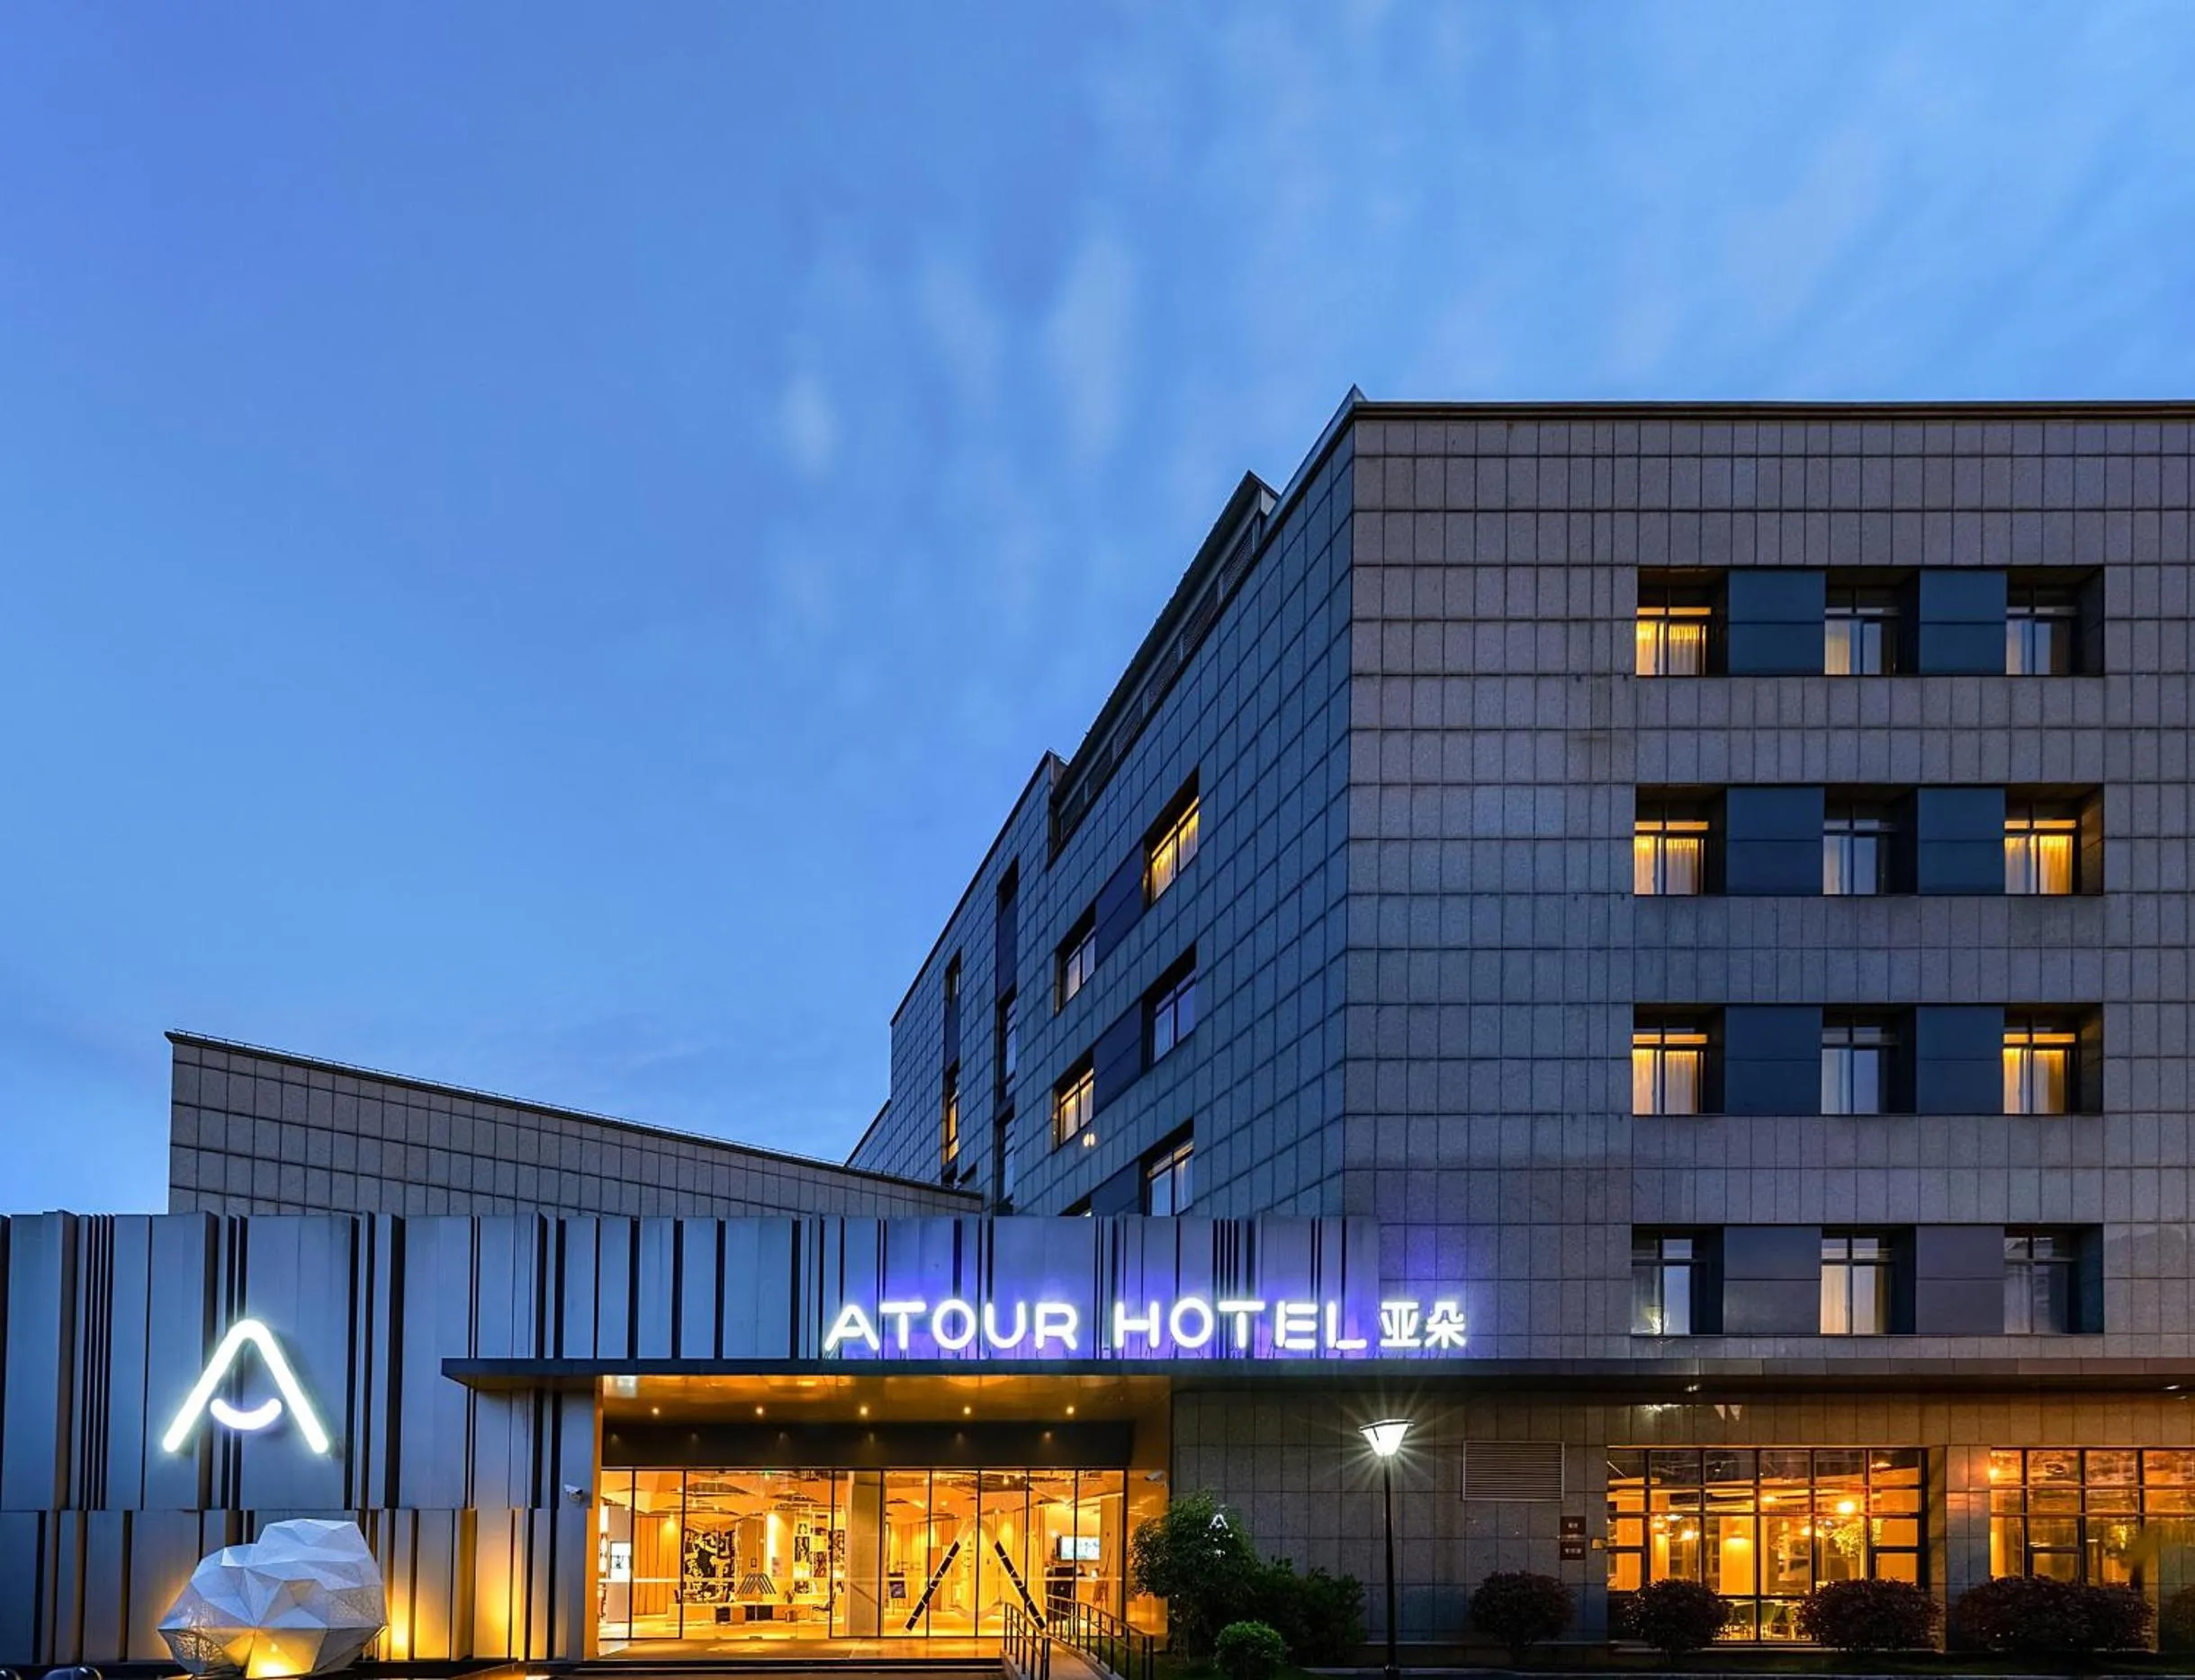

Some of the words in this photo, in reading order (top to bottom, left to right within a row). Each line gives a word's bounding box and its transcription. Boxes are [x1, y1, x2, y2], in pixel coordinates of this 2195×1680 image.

[823, 1298, 1079, 1352] ATOUR
[1112, 1297, 1368, 1351] HOTEL
[1379, 1300, 1467, 1349] 亚朵
[161, 1317, 329, 1454] A
